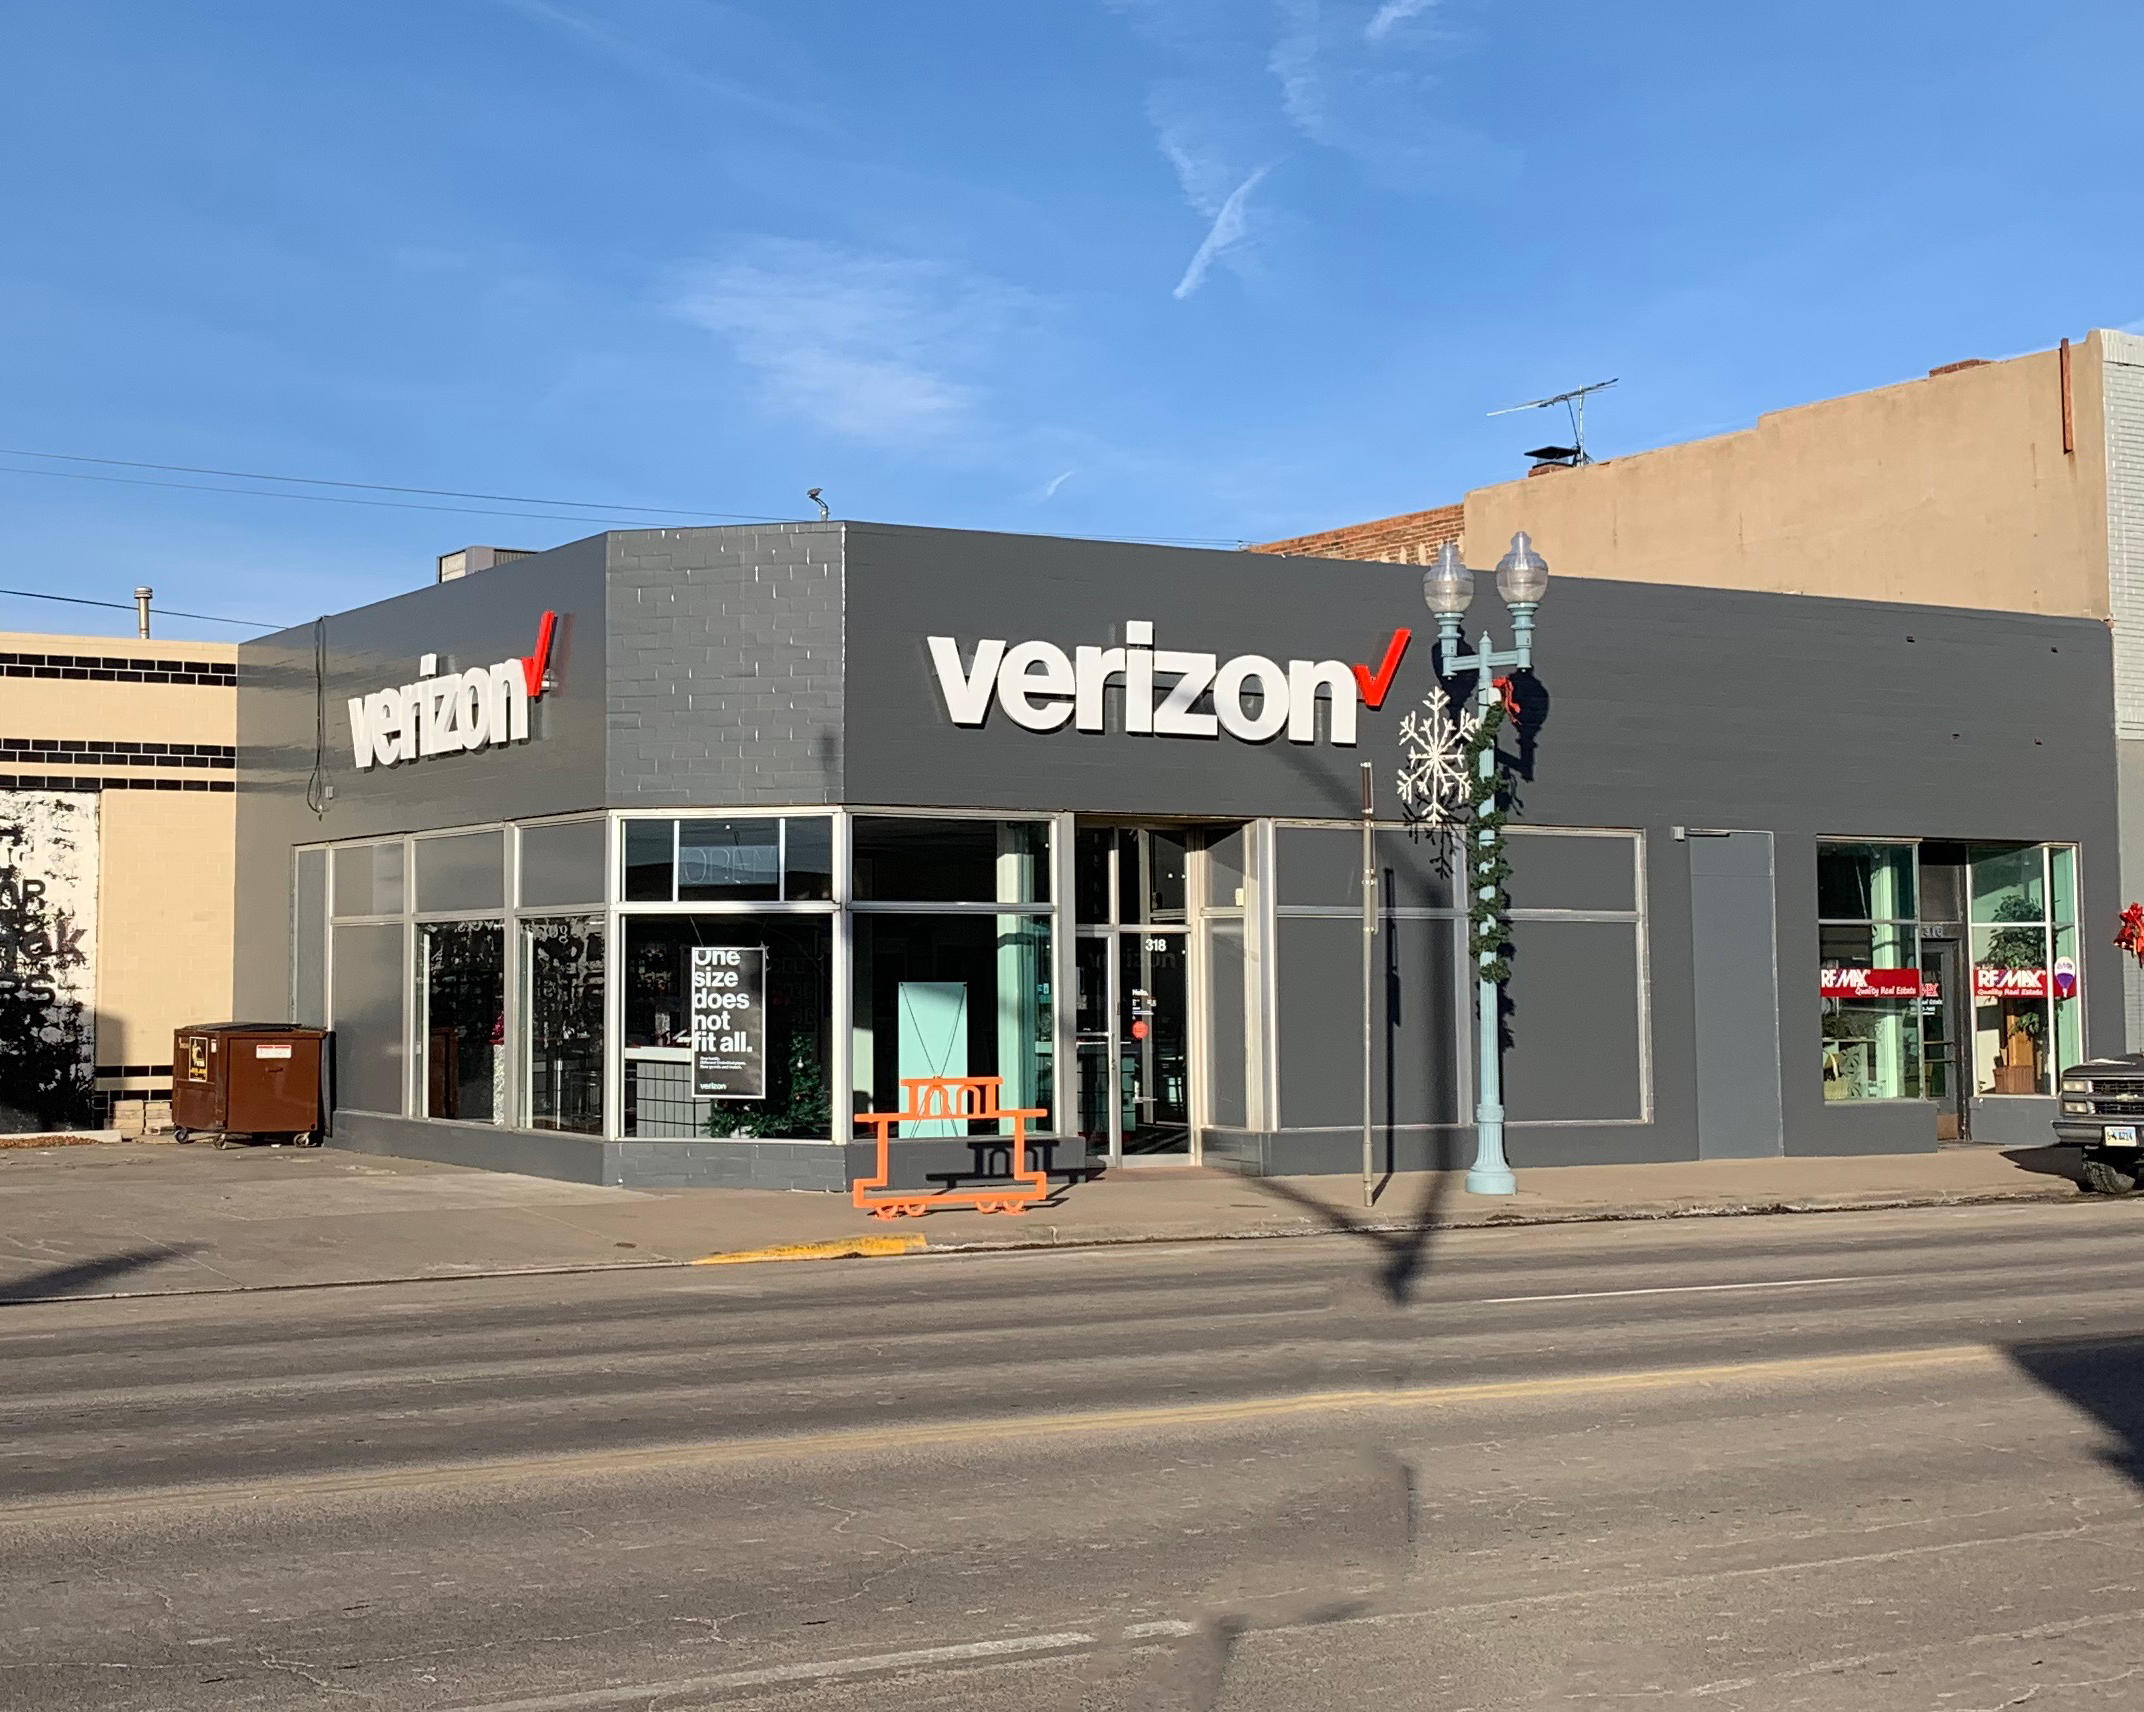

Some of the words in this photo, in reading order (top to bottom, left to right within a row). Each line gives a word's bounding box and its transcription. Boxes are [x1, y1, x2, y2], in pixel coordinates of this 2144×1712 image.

[927, 620, 1357, 745] verizon
[347, 653, 528, 768] verizon
[1145, 939, 1167, 952] 318
[694, 949, 741, 966] One
[694, 966, 739, 987] size
[694, 988, 750, 1010] does
[1855, 986, 1880, 997] Quality
[1881, 986, 1895, 995] Real
[1896, 986, 1917, 995] Estate
[1977, 988, 2003, 997] Quality
[2021, 988, 2044, 996] Estate
[694, 1010, 731, 1031] not
[694, 1031, 717, 1053] fit
[719, 1031, 753, 1053] all.
